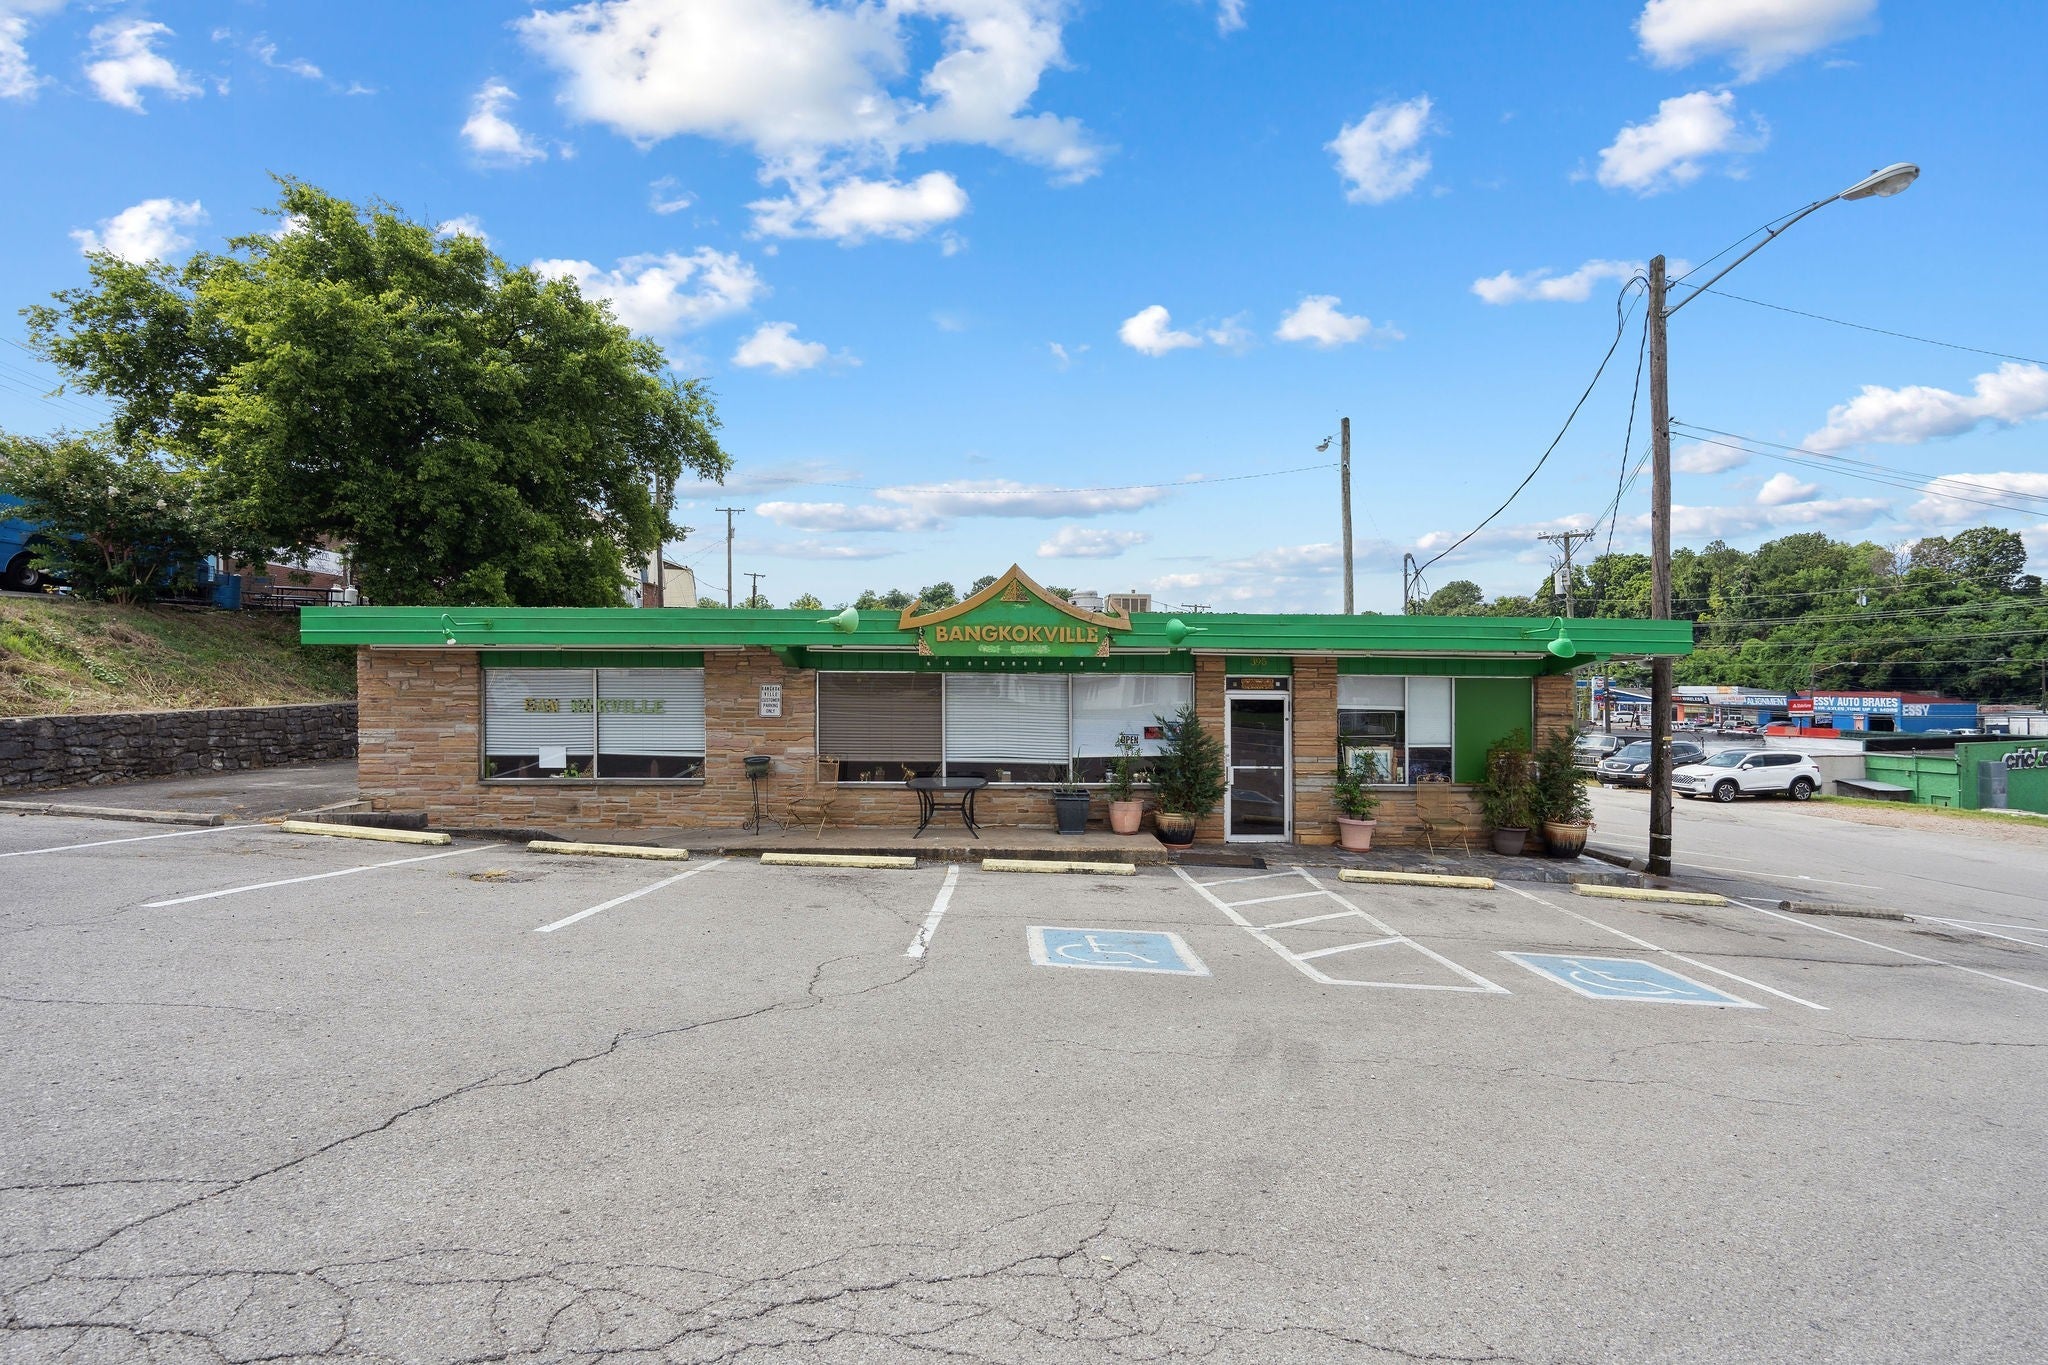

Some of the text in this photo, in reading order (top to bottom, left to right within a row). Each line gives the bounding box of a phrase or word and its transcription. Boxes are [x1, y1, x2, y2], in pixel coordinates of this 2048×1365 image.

[936, 625, 1099, 643] BANGKOKVILLE
[1746, 697, 1787, 706] ALIGNMENT
[1837, 697, 1859, 707] AUTO
[1863, 697, 1899, 708] BRAKES
[1120, 735, 1139, 744] OPEN
